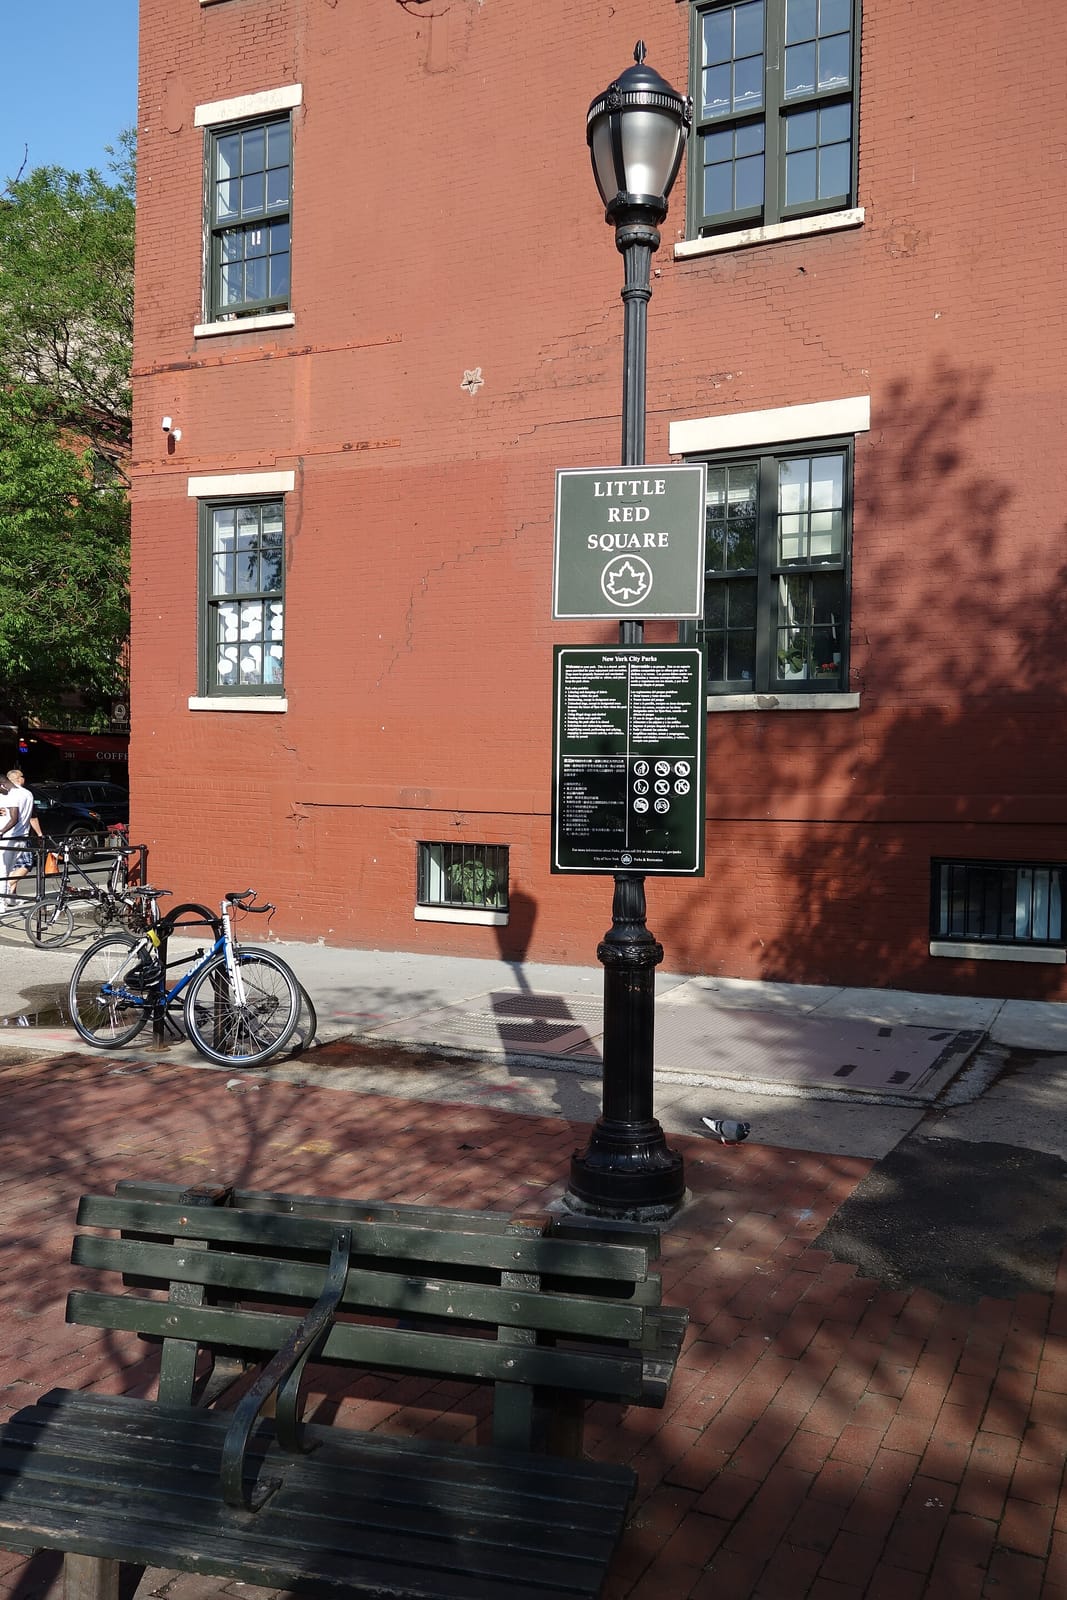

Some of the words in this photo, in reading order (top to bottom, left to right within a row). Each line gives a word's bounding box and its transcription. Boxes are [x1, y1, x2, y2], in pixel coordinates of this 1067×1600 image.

[593, 479, 666, 497] LITTLE
[607, 506, 650, 523] RED
[587, 532, 669, 552] SQUARE
[628, 655, 641, 663] City
